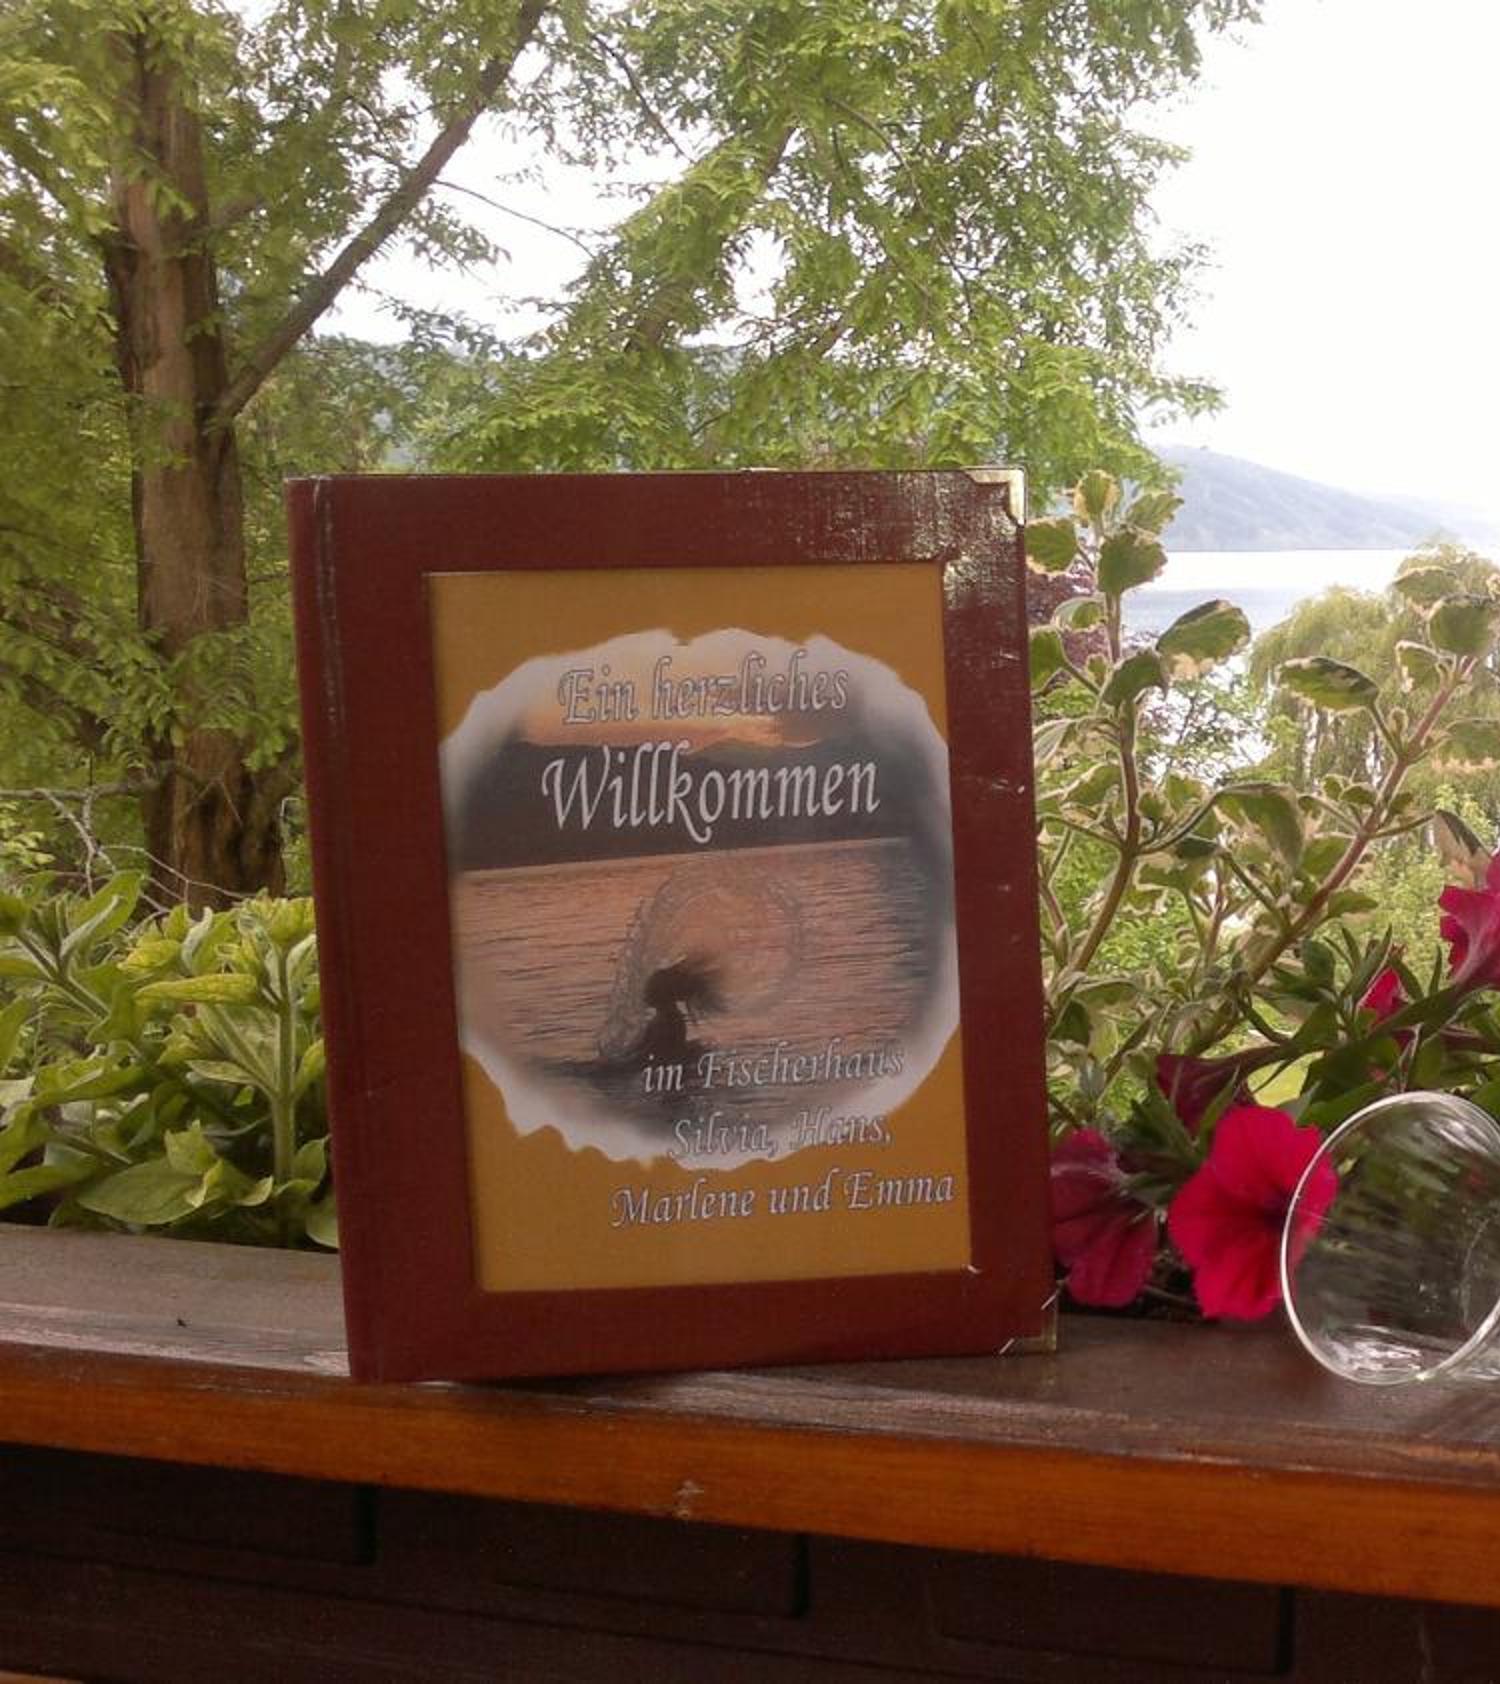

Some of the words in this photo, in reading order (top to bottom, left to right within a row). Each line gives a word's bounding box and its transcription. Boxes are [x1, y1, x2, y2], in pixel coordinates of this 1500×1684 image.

[558, 668, 638, 726] Ein
[650, 651, 850, 718] herzliches
[541, 741, 881, 844] Willkommen
[642, 1052, 684, 1094] im
[697, 1040, 904, 1090] Fischerhaus
[668, 1111, 778, 1160] Silvia,
[610, 1178, 755, 1228] Marlene
[768, 1171, 833, 1212] und
[844, 1170, 954, 1210] Emma
